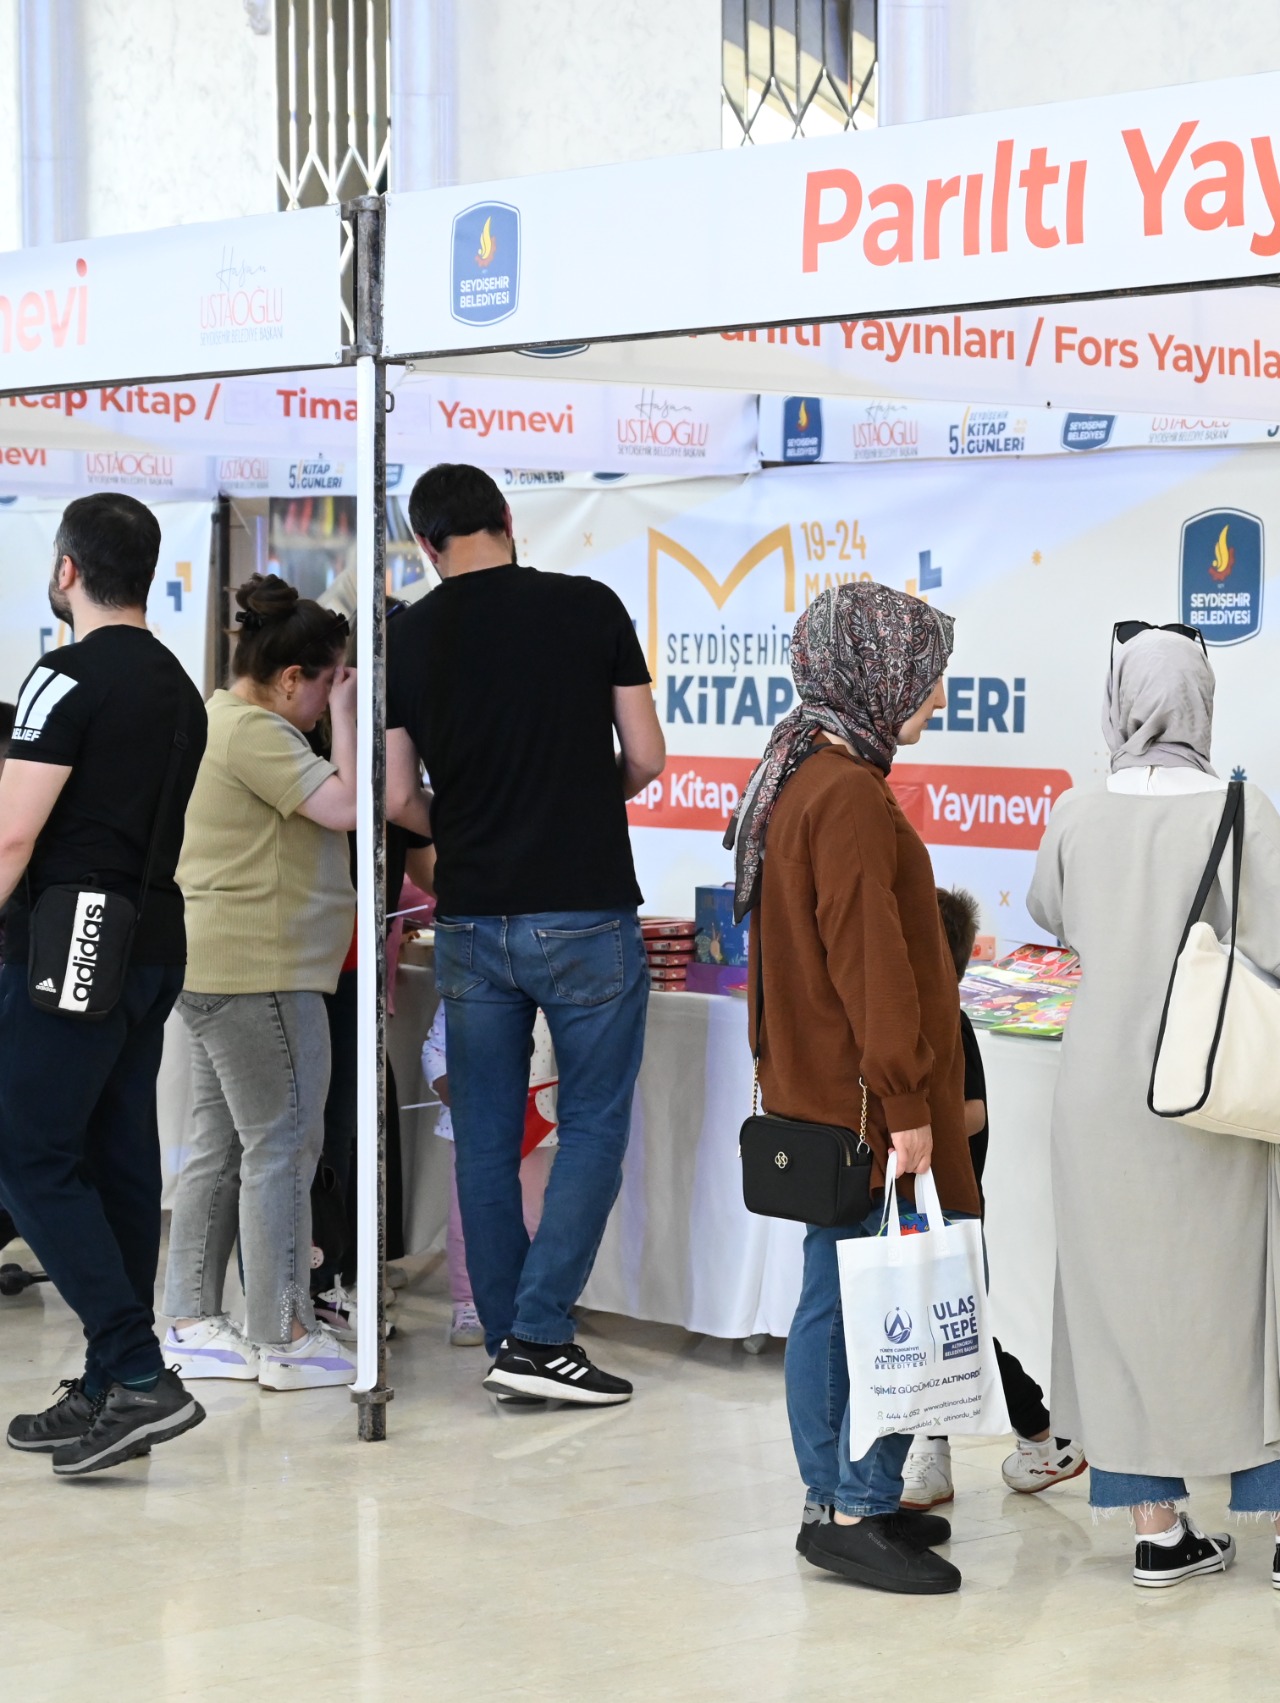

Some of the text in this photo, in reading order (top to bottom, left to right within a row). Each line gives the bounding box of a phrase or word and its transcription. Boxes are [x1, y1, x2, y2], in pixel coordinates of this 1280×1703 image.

[803, 139, 1088, 274] Parıltı
[1054, 326, 1139, 369] Fors
[276, 387, 357, 421] Tima
[437, 400, 574, 437] Yayınevi
[801, 519, 866, 561] 19-24
[670, 770, 739, 818] Kitap
[927, 784, 1052, 832] Yayınevi
[73, 904, 104, 1002] adidas
[874, 1352, 927, 1363] ALTINORDU
